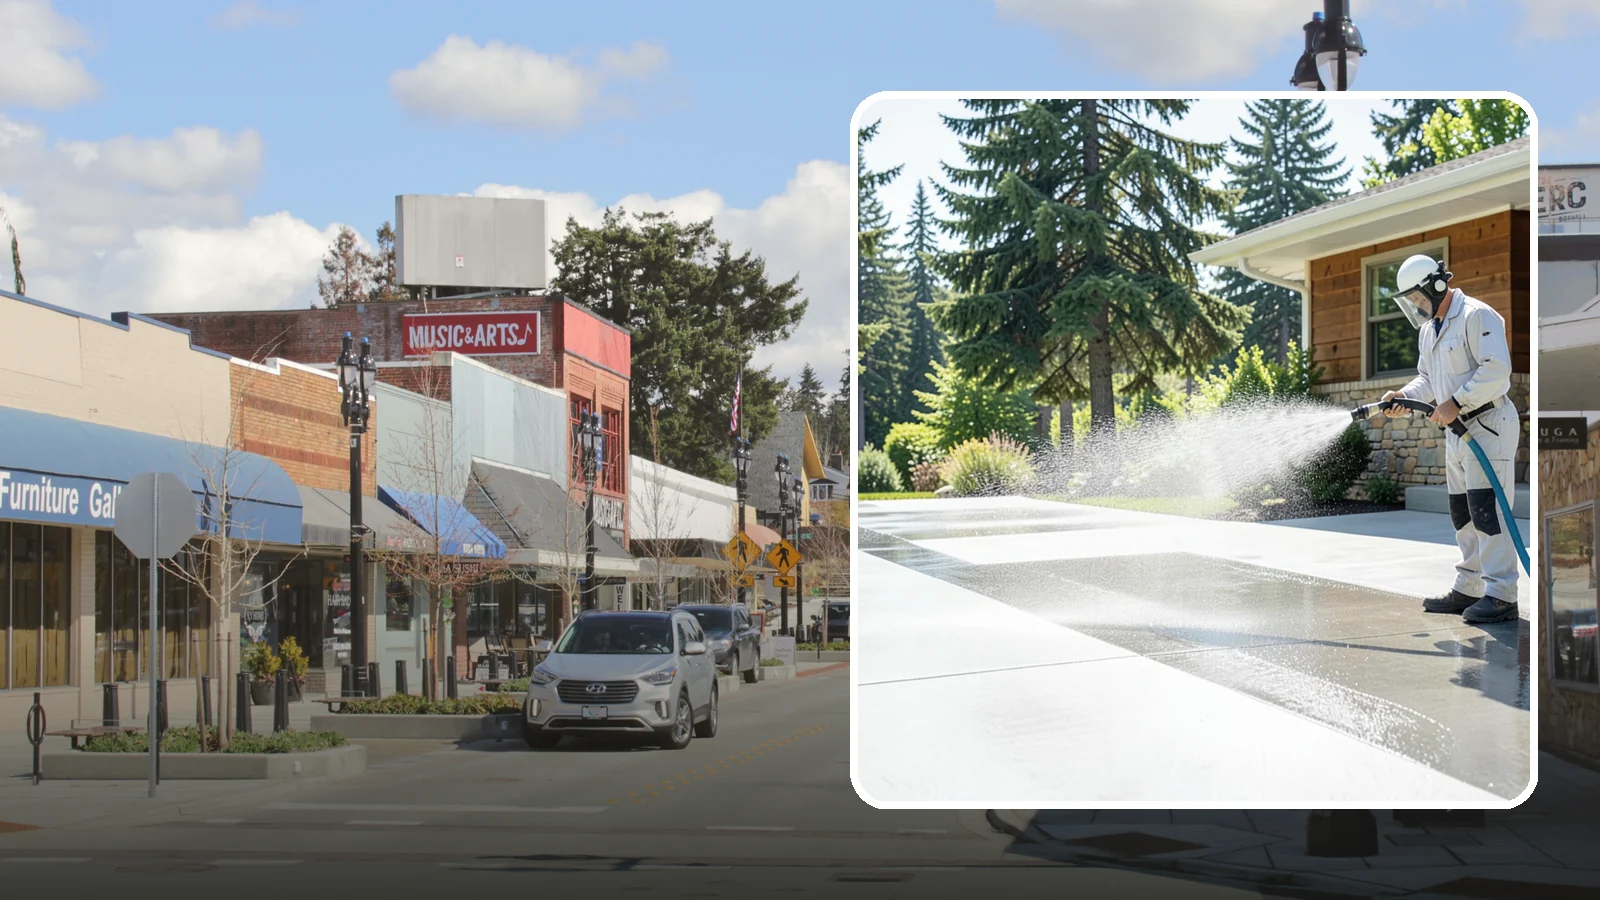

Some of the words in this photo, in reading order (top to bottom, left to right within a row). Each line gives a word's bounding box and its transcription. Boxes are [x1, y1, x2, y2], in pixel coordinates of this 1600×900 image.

[409, 323, 519, 349] MUSIC&ARTS
[0, 472, 79, 515] Furniture
[90, 483, 121, 519] Gal
[453, 563, 478, 574] SUSHI
